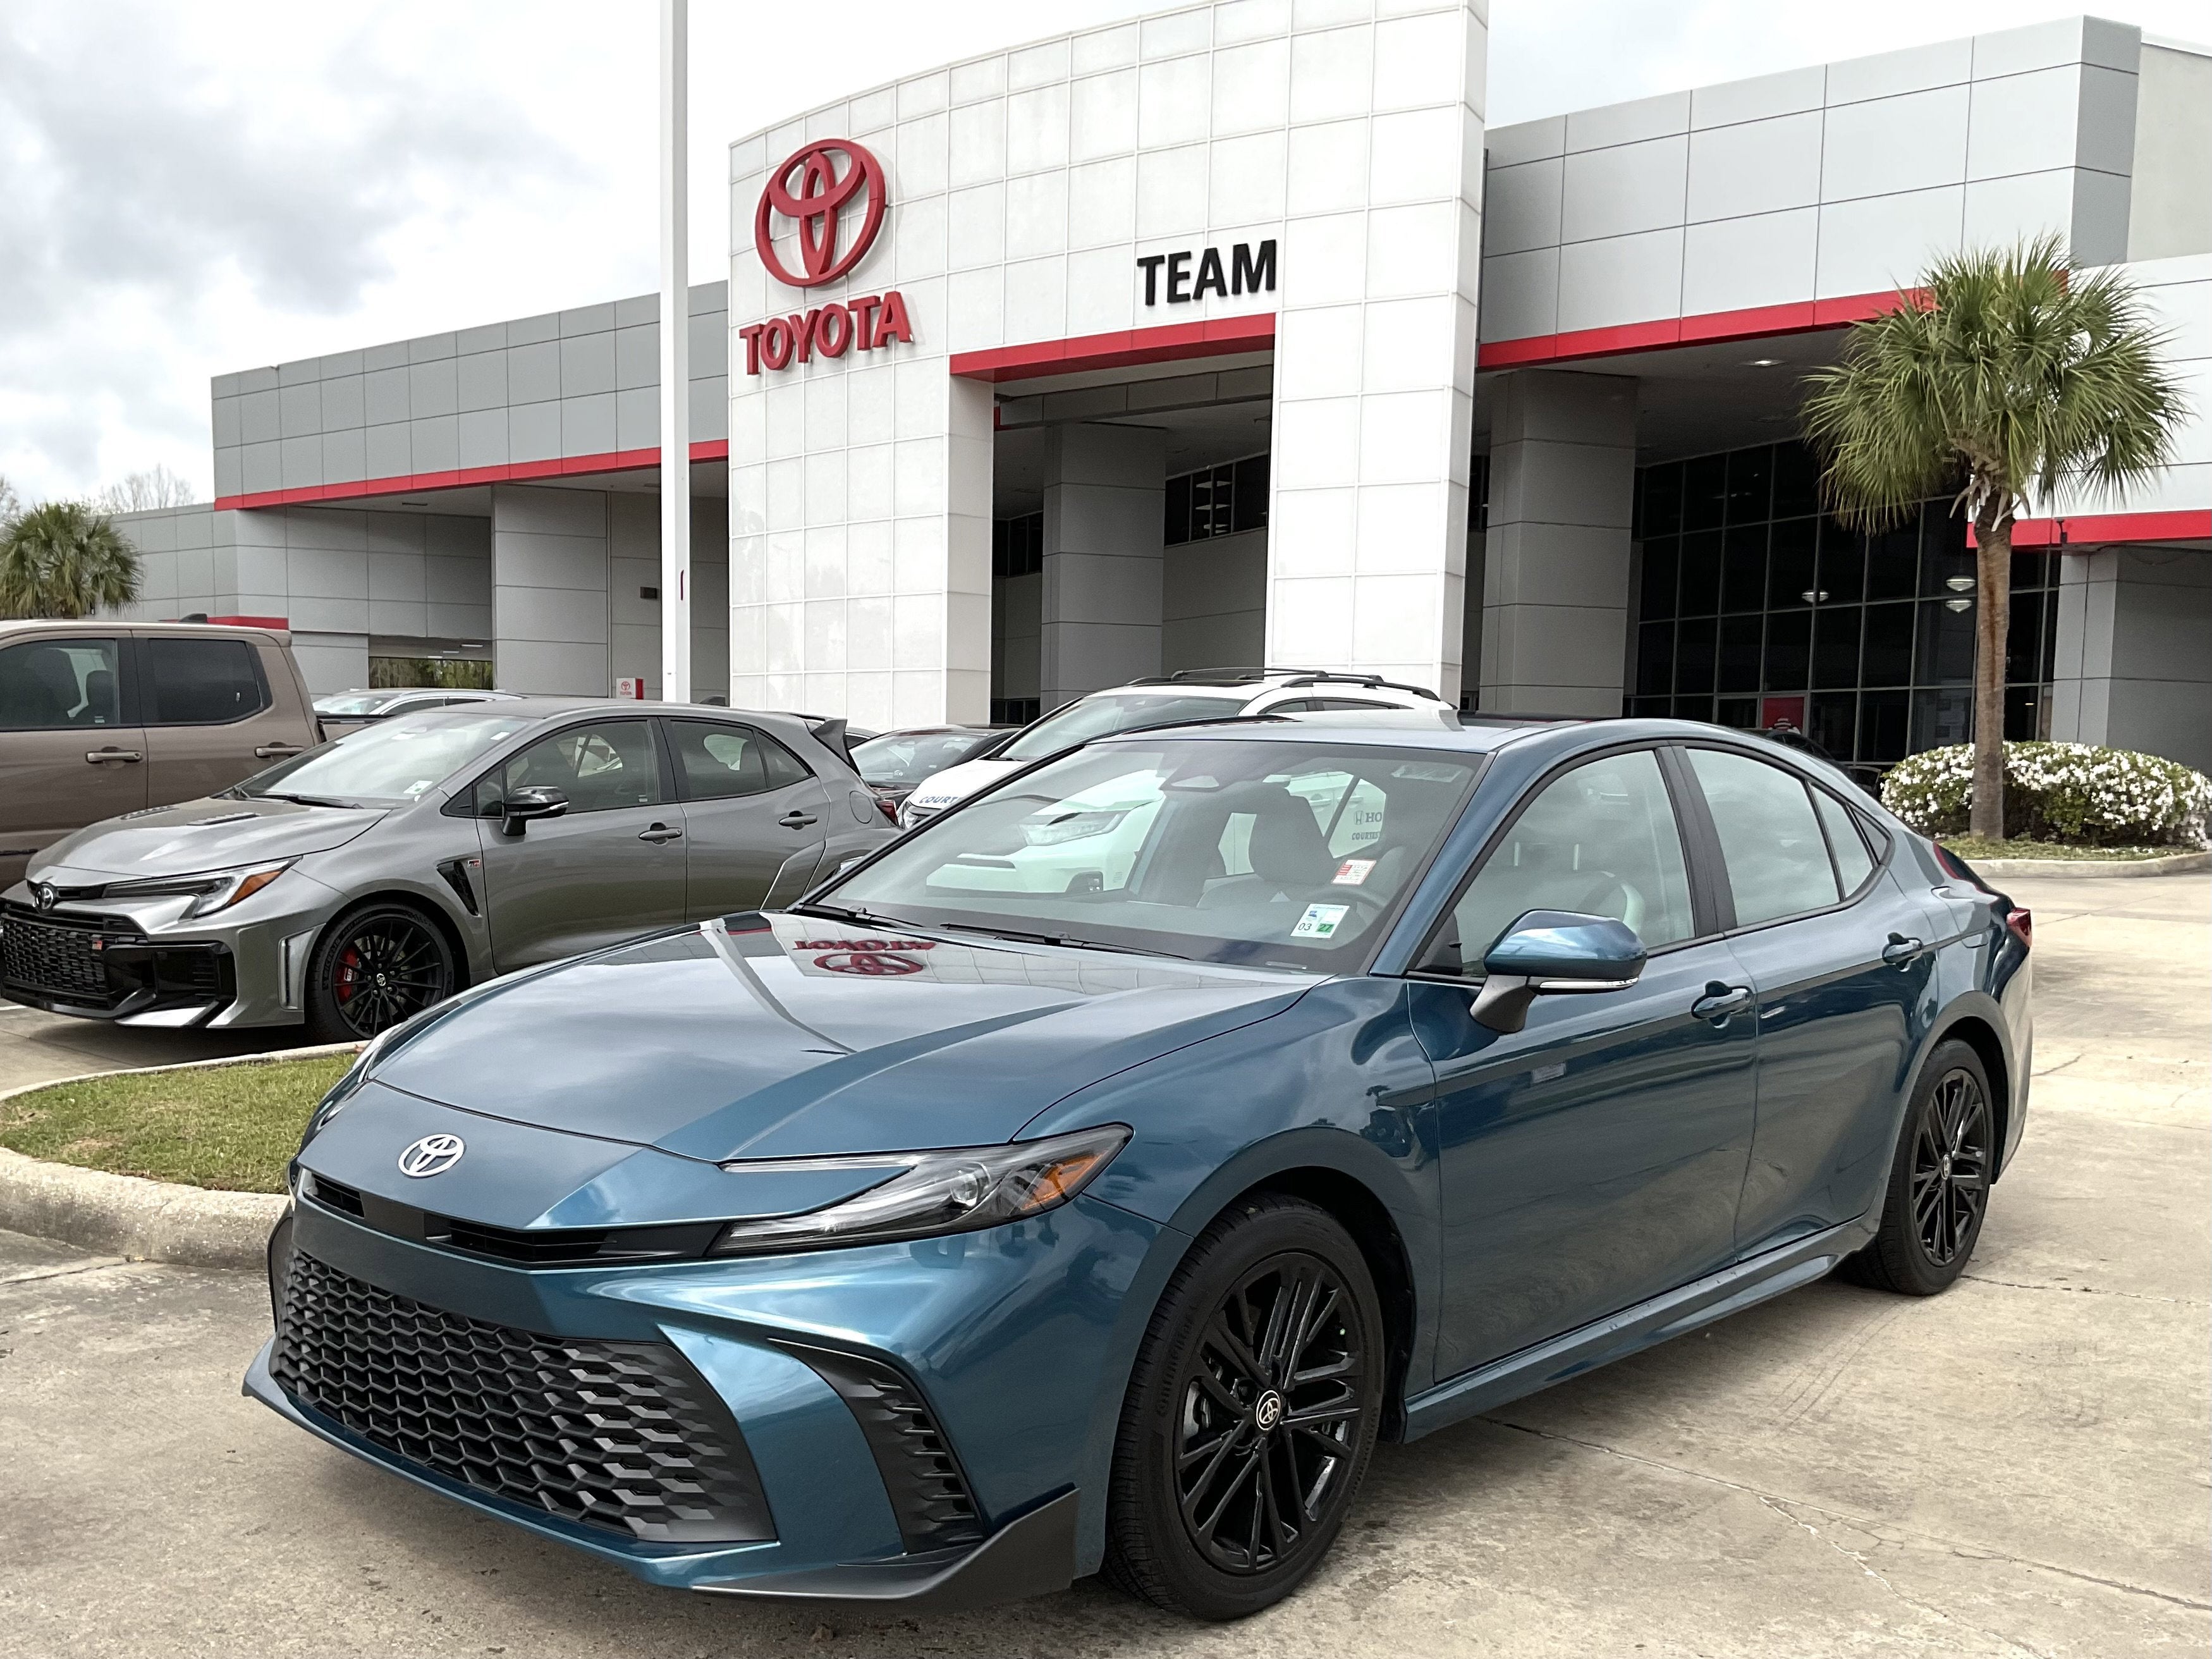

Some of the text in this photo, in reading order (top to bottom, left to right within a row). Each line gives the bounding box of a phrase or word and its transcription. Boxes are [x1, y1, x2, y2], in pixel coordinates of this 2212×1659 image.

[1137, 239, 1276, 307] TEAM
[739, 291, 914, 376] TOYOTA
[1298, 922, 1312, 931] 03
[1317, 924, 1334, 932] 27
